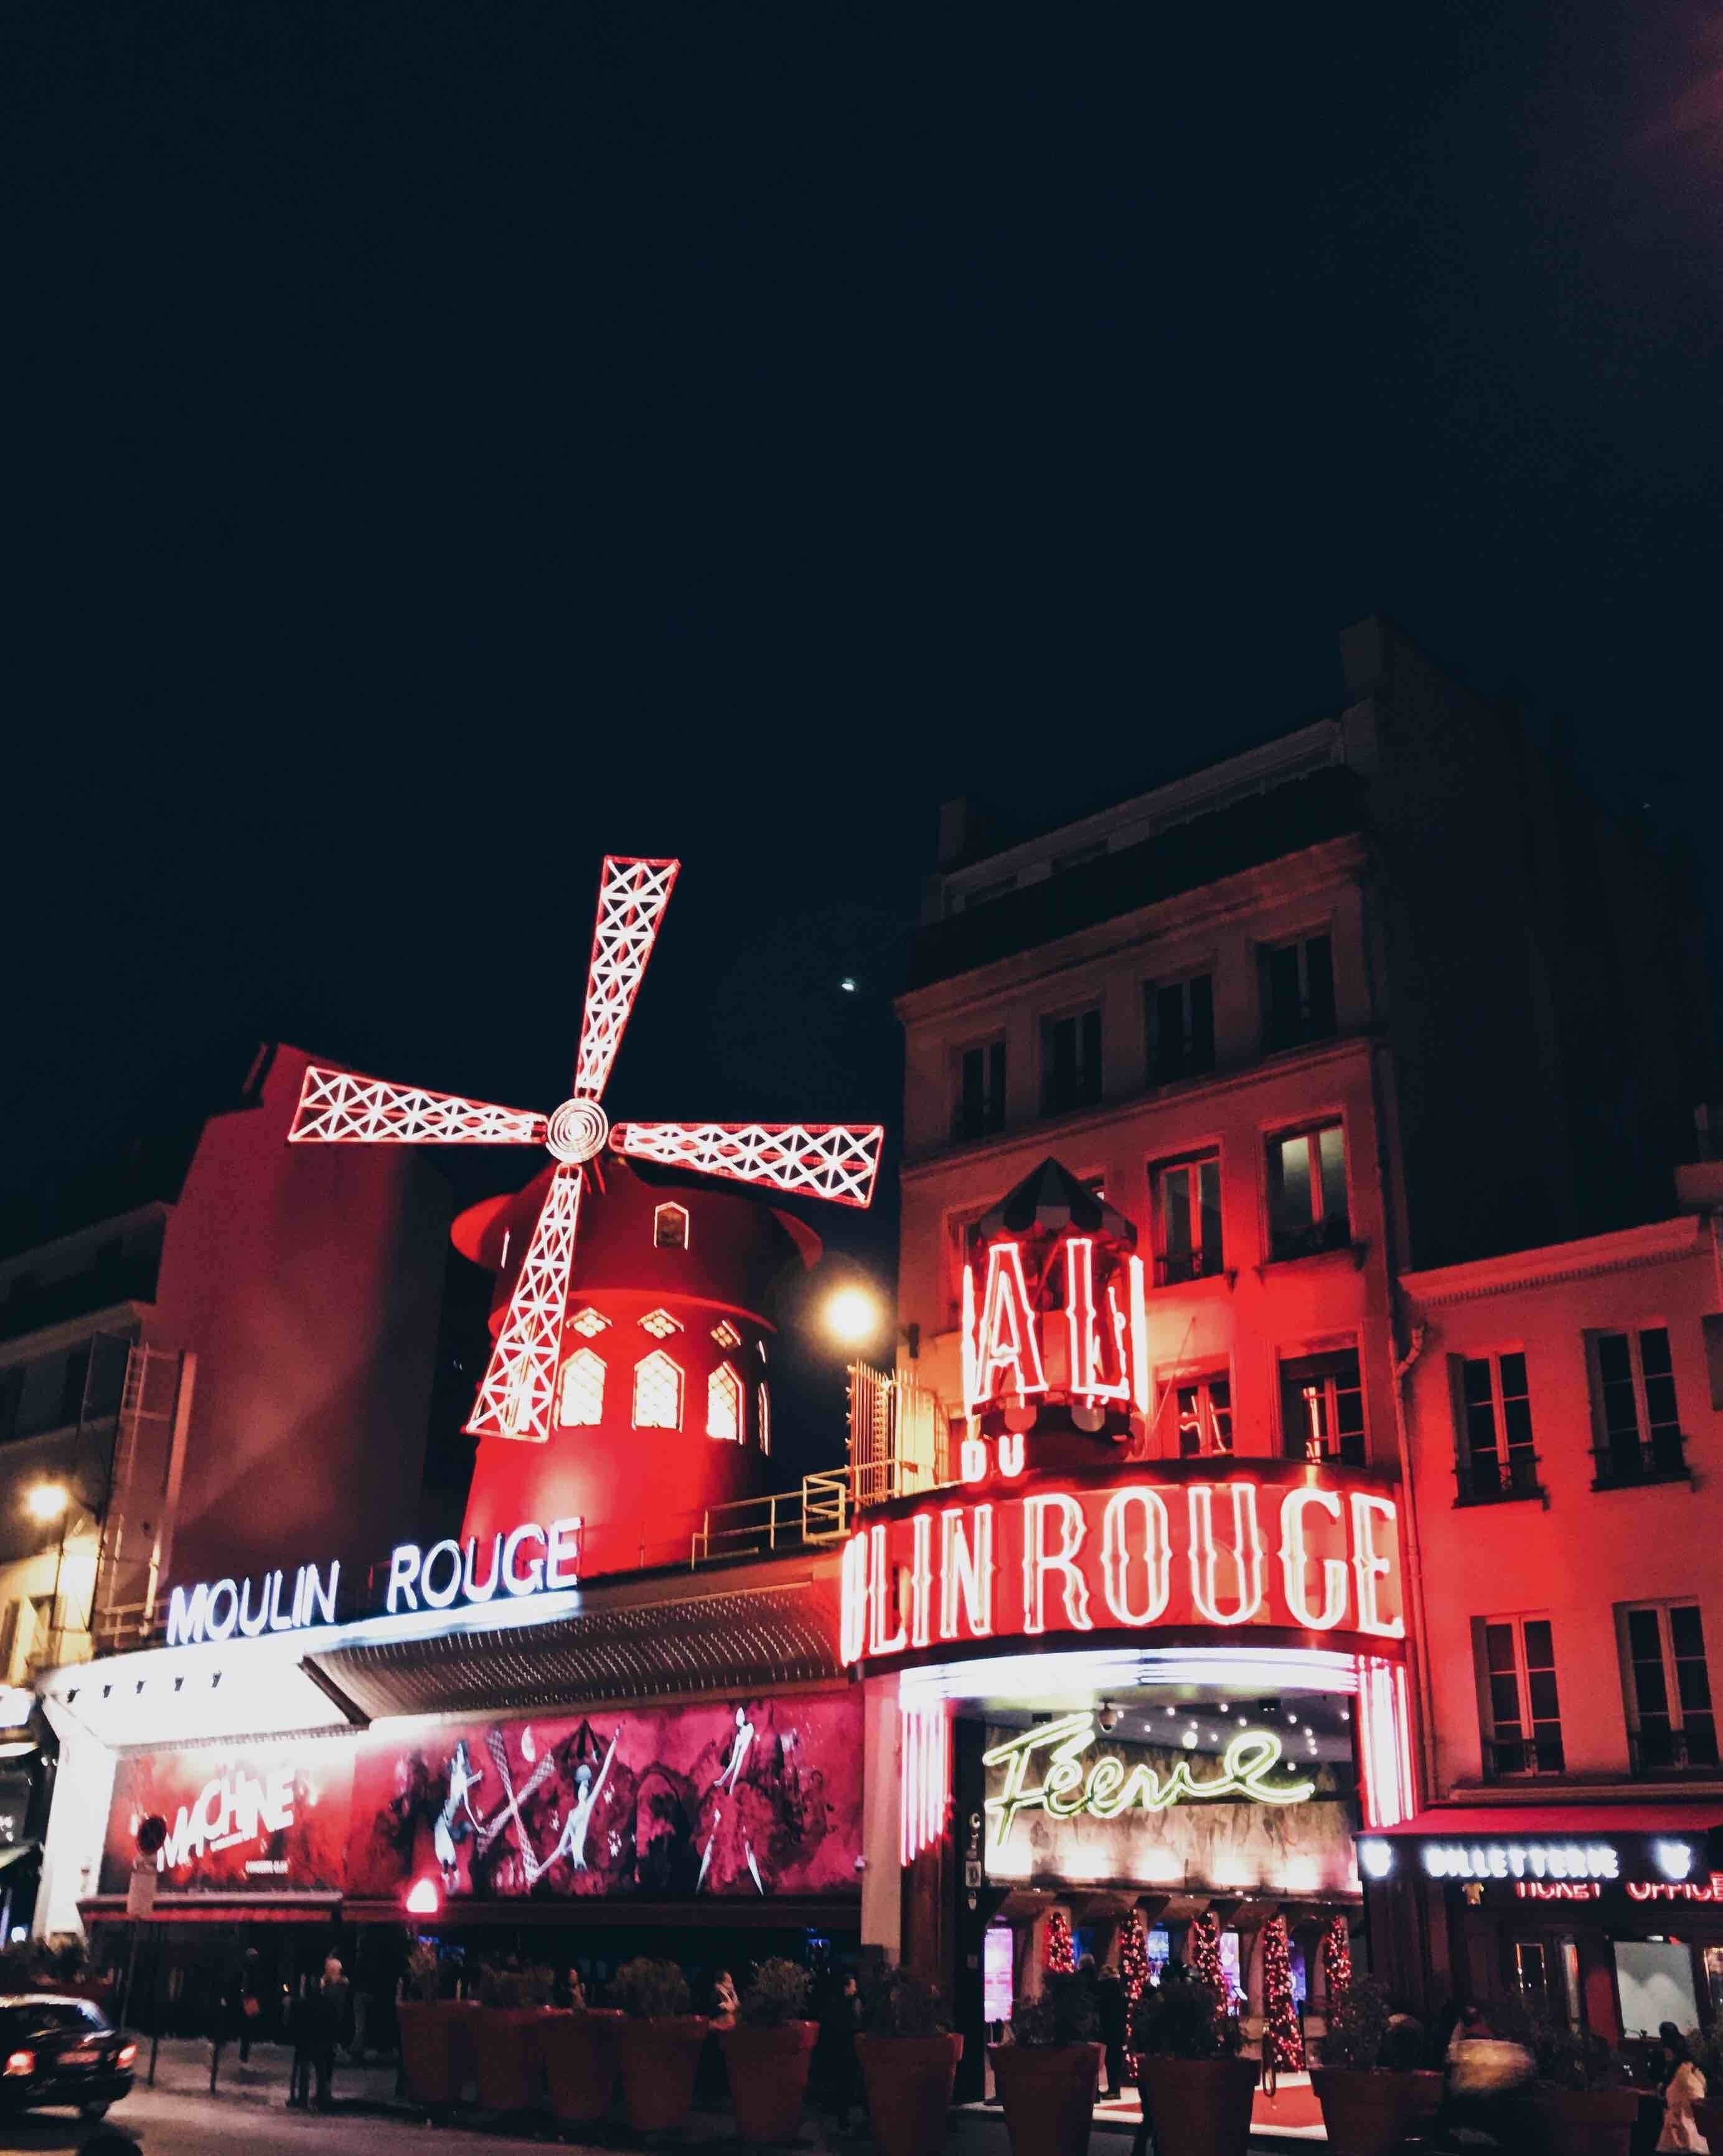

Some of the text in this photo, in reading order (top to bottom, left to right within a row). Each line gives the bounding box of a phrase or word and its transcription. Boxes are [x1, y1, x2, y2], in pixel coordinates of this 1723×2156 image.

[962, 1238, 1130, 1413] AL
[961, 1433, 1025, 1483] DU
[166, 1516, 581, 1646] MOULIN ROUGE
[1022, 1483, 1406, 1638] ROUGE
